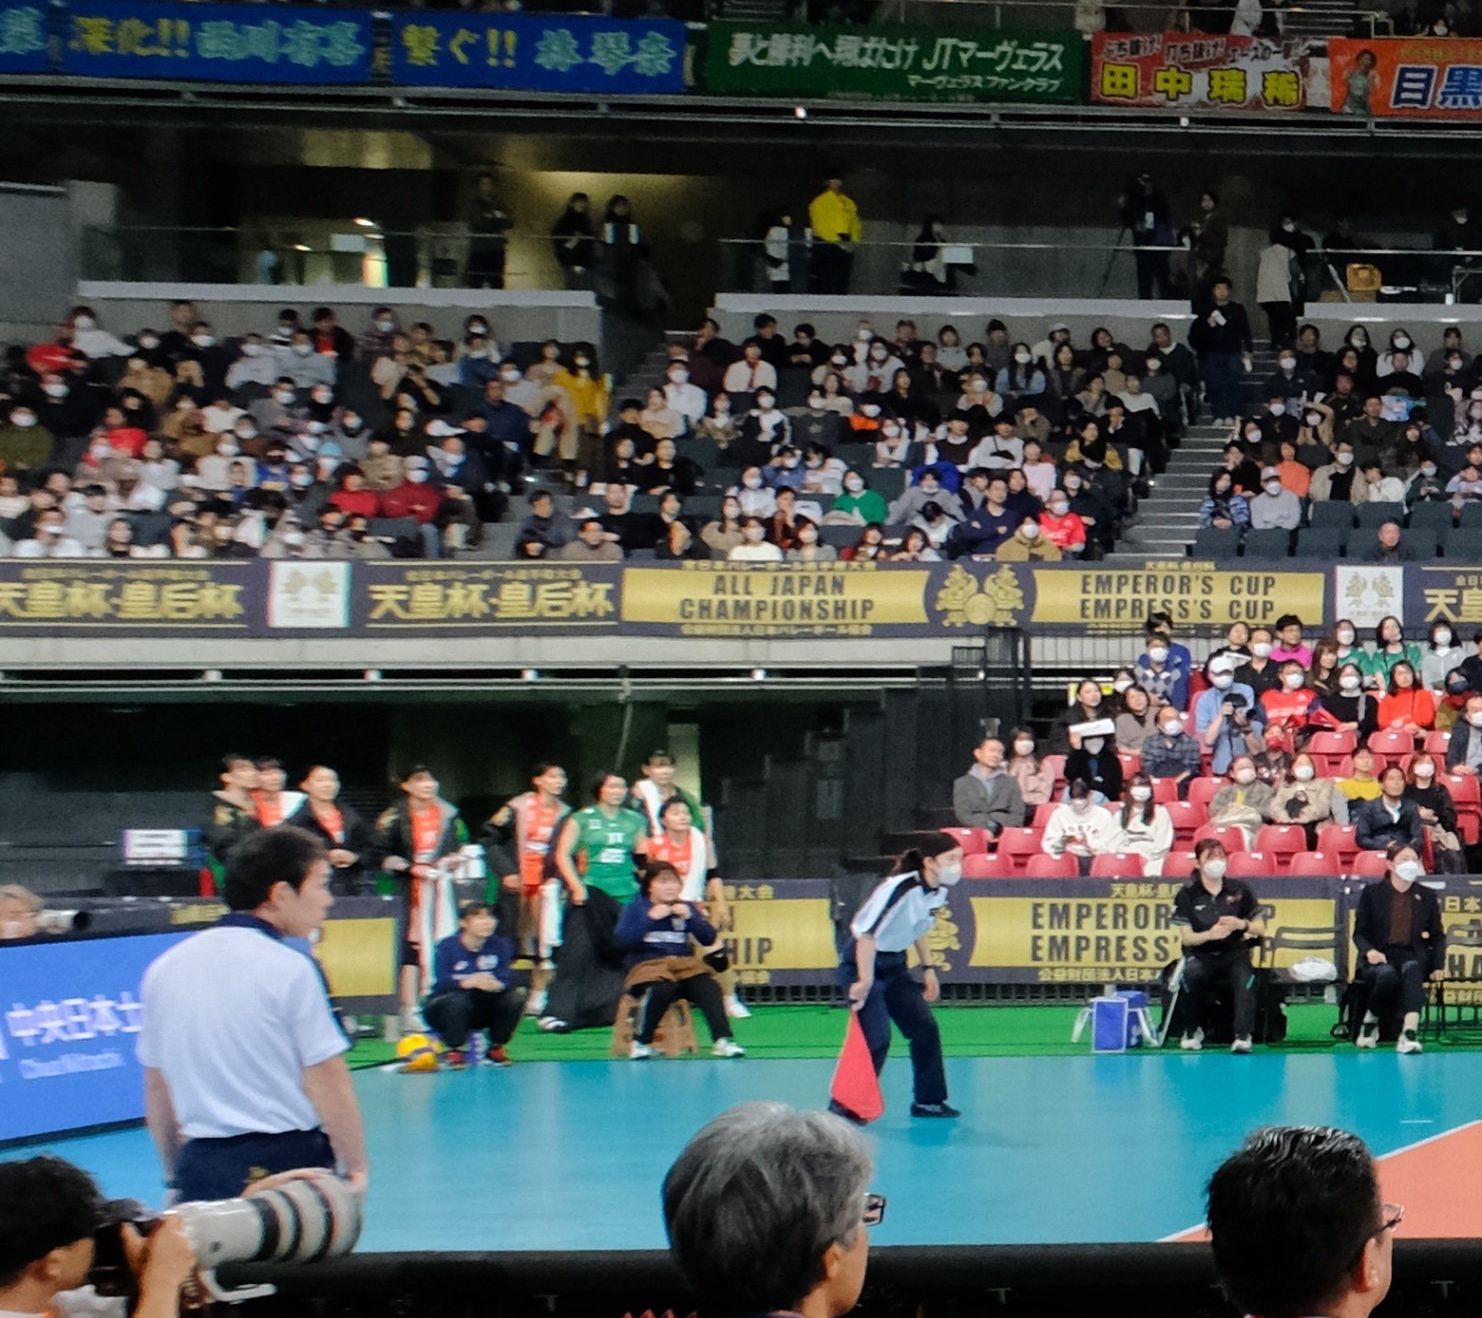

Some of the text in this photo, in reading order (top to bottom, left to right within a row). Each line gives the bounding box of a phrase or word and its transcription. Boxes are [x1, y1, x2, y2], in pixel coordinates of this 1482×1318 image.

[922, 37, 1064, 71] JTマーヴェラス
[1101, 62, 1303, 108] 田中瑞稀
[713, 574, 845, 595] ALL JAPAN
[1081, 575, 1276, 595] EMPEROR'S CUP
[680, 599, 875, 620] CHAMPIONSHIP
[1080, 599, 1275, 619] EMPRESS'S CUP
[1031, 902, 1170, 930] EMPEROR
